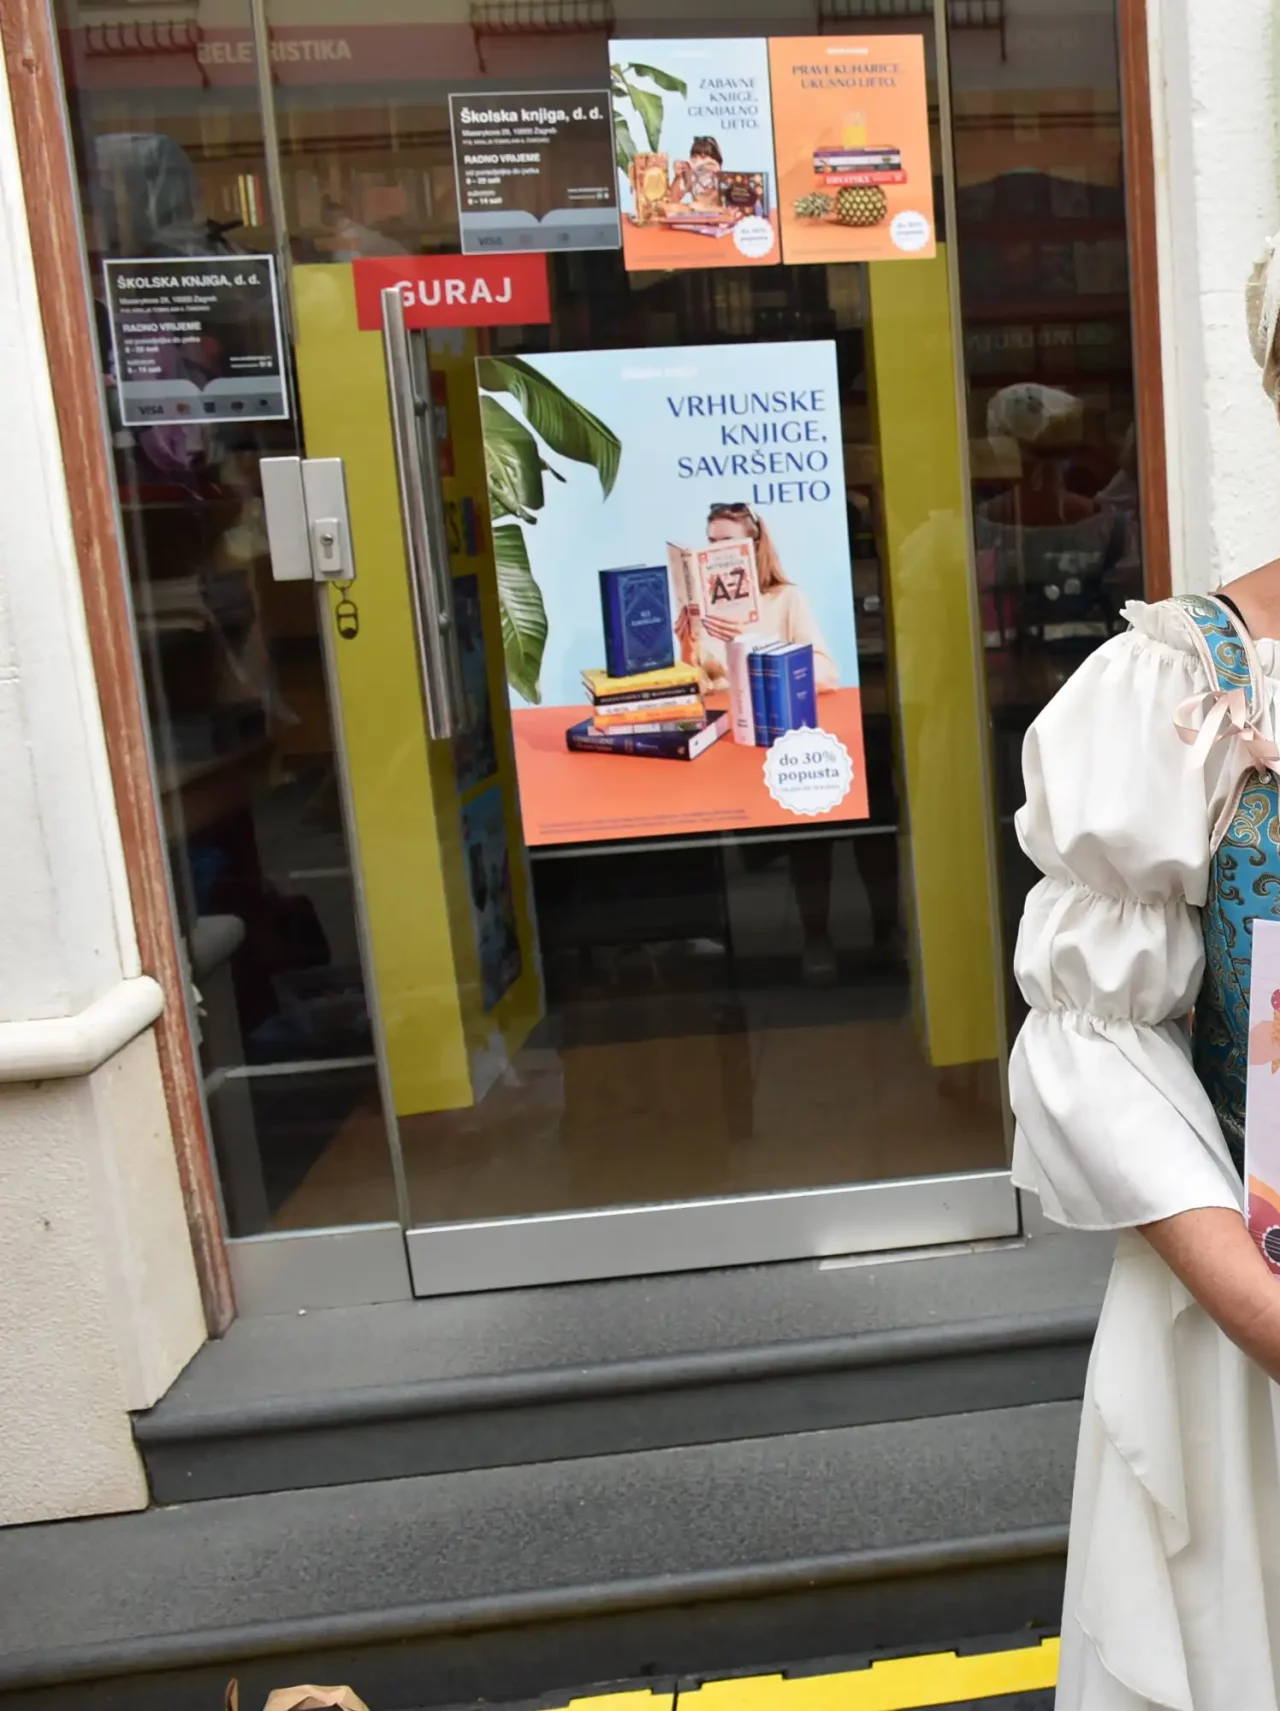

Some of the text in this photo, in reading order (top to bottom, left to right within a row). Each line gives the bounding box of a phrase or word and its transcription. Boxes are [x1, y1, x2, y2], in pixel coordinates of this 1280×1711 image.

[197, 39, 352, 64] BELERISTIKA
[792, 64, 830, 76] PRAVE
[700, 77, 757, 90] ZABAVNE
[801, 77, 857, 90] UKUSNO
[460, 106, 604, 125] Školska knjiga, d. d.
[687, 105, 759, 118] GENIJALNO
[464, 153, 540, 165] RADNO VRIJEME
[117, 274, 261, 289] ŠKOLSKA KNJIGA, d. d.
[393, 276, 513, 308] GURAJ
[122, 321, 202, 333] RADNO VRIJEME
[138, 405, 164, 416] VISA
[666, 389, 827, 418] VRHUNSKE
[720, 420, 828, 446] KNJIGE,
[677, 447, 829, 480] SAVRŠENO
[752, 480, 832, 505] LJETO
[710, 568, 750, 606] A-Z
[779, 749, 837, 768] do 30%
[777, 765, 840, 786] popusta
